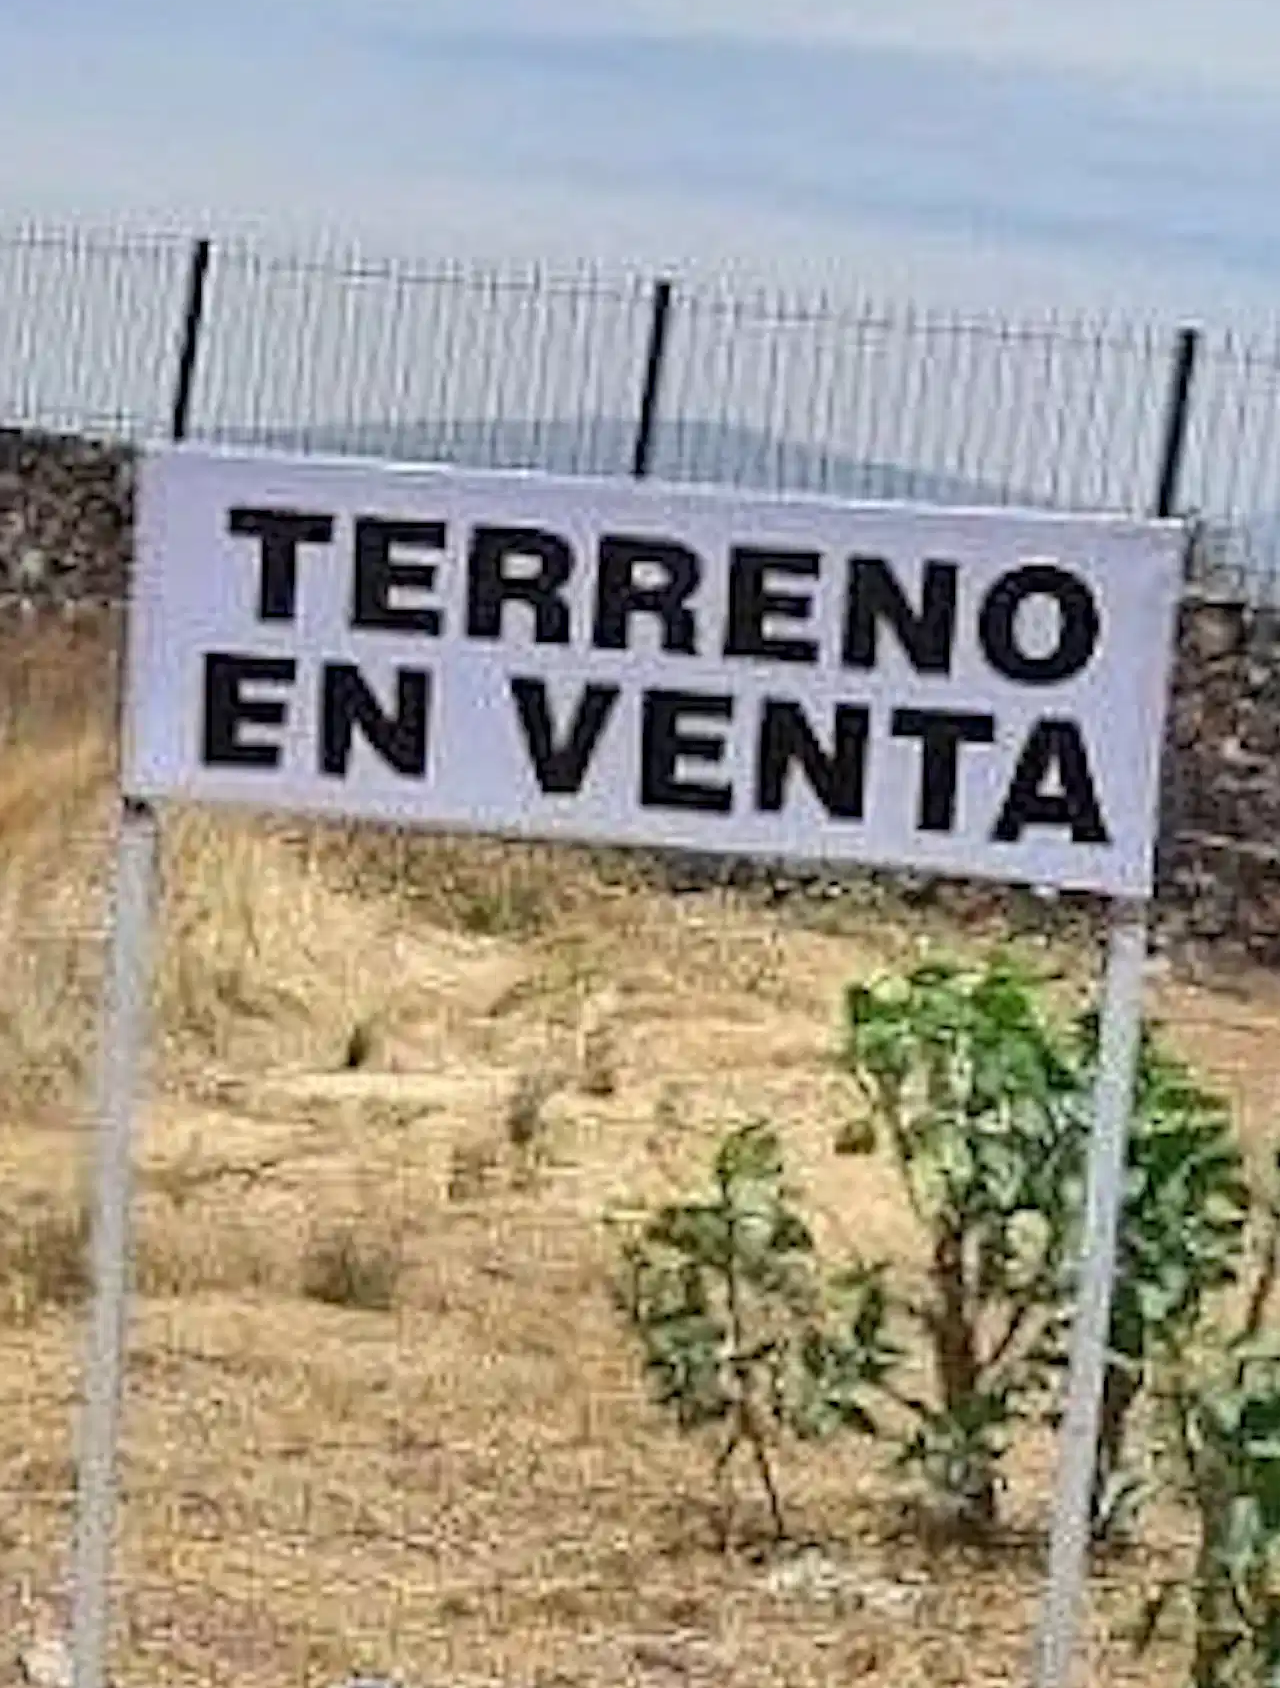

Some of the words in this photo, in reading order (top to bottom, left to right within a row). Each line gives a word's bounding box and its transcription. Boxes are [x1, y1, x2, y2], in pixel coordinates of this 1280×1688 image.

[227, 504, 1102, 688] TERRENO
[199, 650, 433, 781] EN
[508, 674, 1114, 848] VENTA
